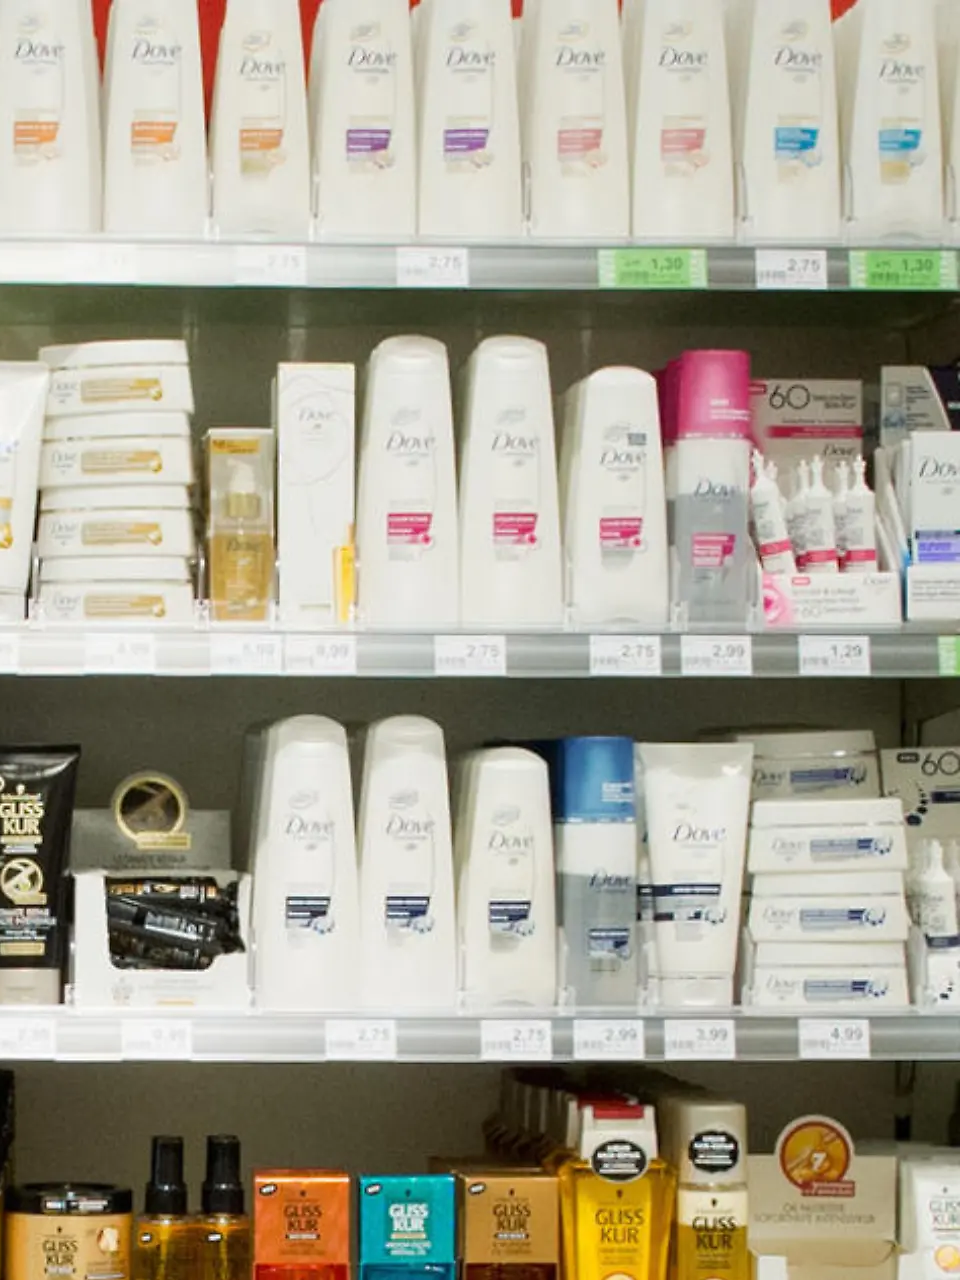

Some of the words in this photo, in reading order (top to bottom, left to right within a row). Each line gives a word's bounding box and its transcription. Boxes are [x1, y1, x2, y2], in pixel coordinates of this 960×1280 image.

[15, 41, 64, 59] Dove
[132, 41, 182, 59] Dove
[348, 48, 397, 67] Dove
[447, 48, 495, 67] Dove
[557, 48, 605, 66] Dove
[659, 48, 708, 66] Dove
[775, 48, 822, 66] Dove
[240, 58, 285, 76] Dove
[880, 60, 925, 78] Dove
[386, 432, 435, 451] Dove
[600, 450, 646, 468] Dove
[919, 459, 960, 479] Dov
[3, 819, 39, 835] KUR
[286, 819, 335, 835] Dove
[386, 819, 435, 835] Dove
[673, 824, 727, 842] Dove
[488, 833, 534, 849] Dove
[595, 1209, 644, 1226] GLISS
[692, 1216, 736, 1233] GLISS
[600, 1227, 639, 1244] KUR
[696, 1233, 732, 1250] KUR
